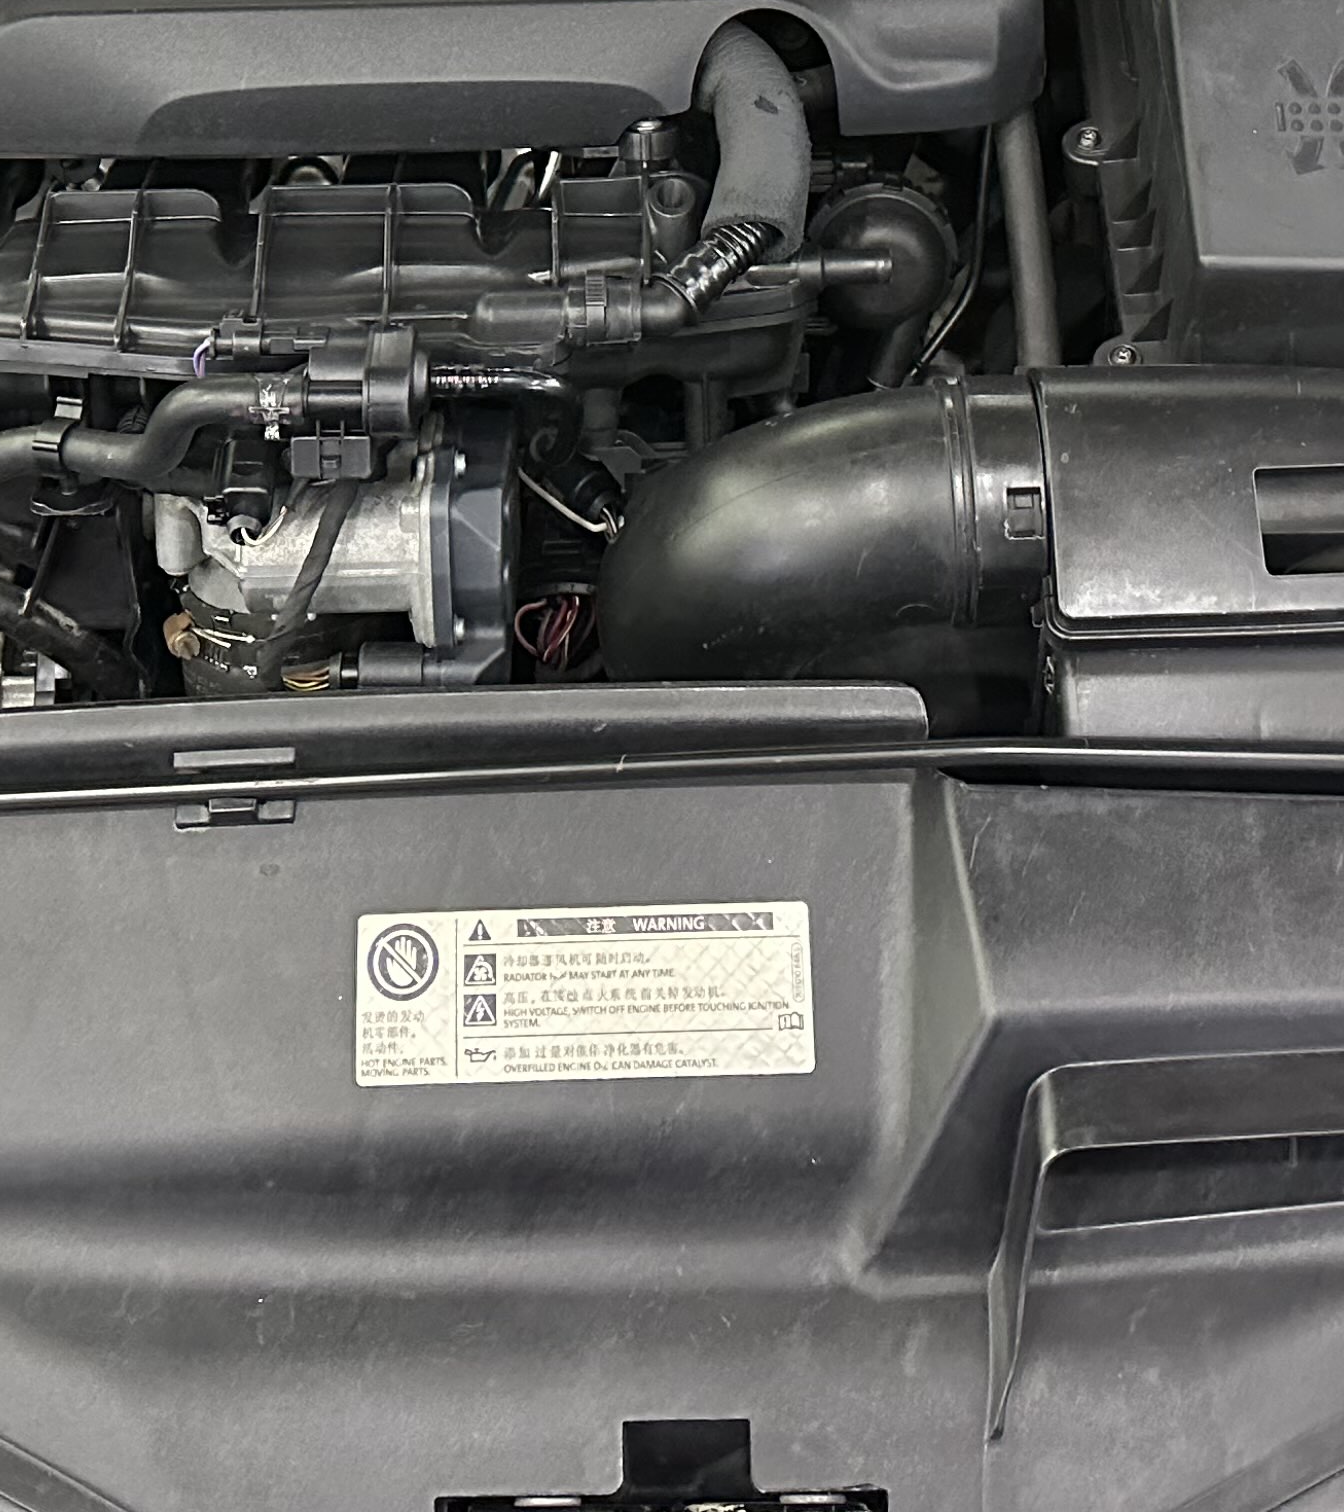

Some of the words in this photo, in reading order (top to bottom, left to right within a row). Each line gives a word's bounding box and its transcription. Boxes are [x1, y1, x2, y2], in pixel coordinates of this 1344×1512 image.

[632, 915, 705, 932] WARNING
[503, 972, 548, 983] RADIATOR
[569, 970, 589, 980] MAY
[591, 969, 617, 980] START
[619, 969, 630, 979] AT
[631, 969, 651, 979] ANY
[503, 1007, 528, 1017] HIGH
[608, 1004, 626, 1015] OFF
[627, 1003, 661, 1014] ENGINE
[663, 1002, 696, 1013] BEFORE
[697, 1001, 747, 1012] TOUCHING
[360, 1058, 380, 1068] HOT
[503, 1062, 556, 1074] OVERFILLED
[611, 1060, 632, 1071] CAN
[633, 1059, 673, 1070] DAMAGE
[360, 1068, 400, 1078] MOVING
